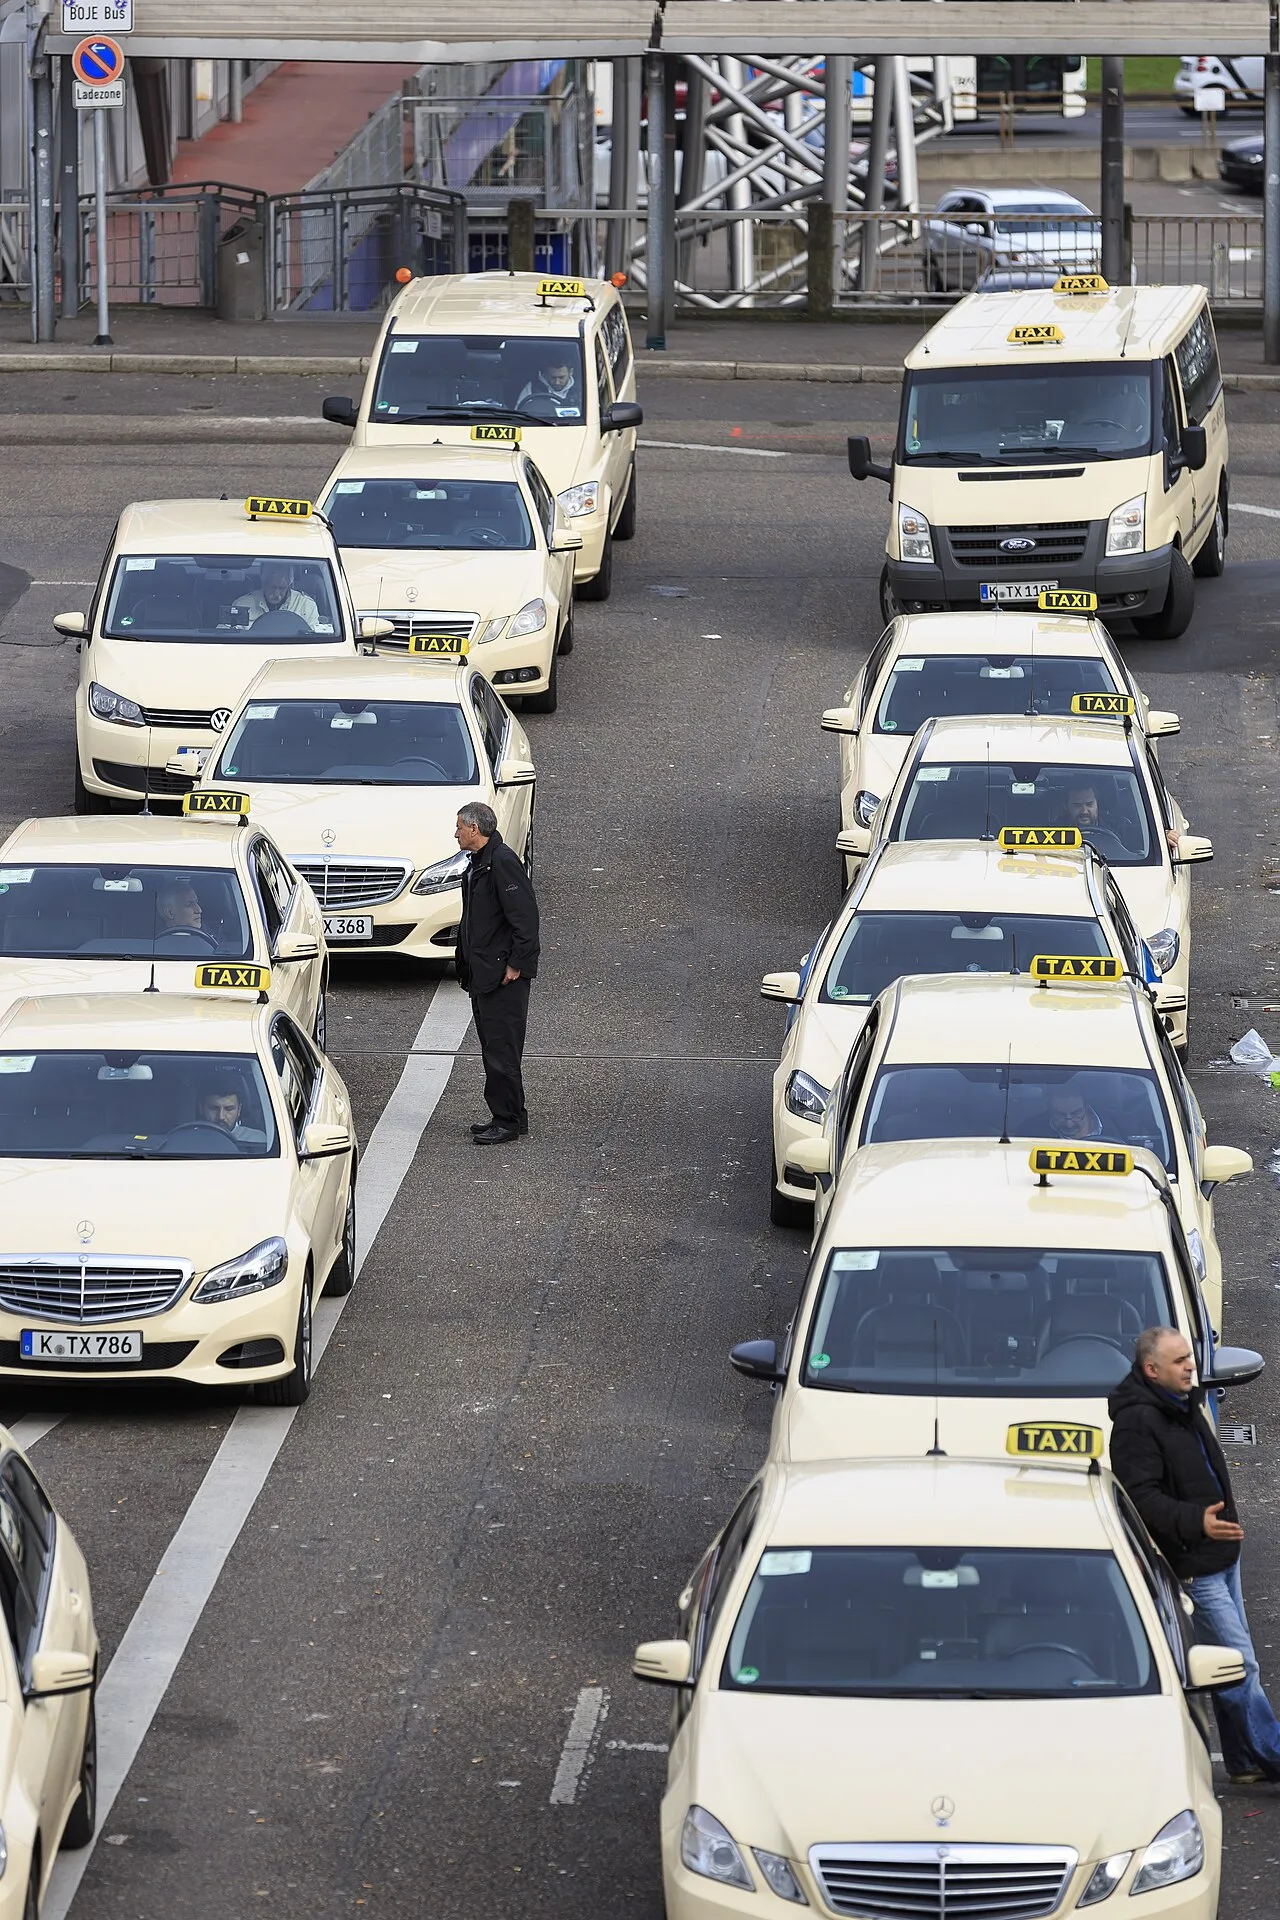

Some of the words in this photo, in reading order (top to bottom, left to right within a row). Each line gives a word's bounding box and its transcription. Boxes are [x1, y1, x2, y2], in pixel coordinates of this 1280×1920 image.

[70, 6, 98, 20] BOJE
[104, 6, 125, 20] Bus
[76, 88, 121, 100] Ladezone
[543, 282, 578, 293] TAXI
[1062, 278, 1099, 289] TAXI
[1016, 326, 1055, 337] TAXI
[479, 426, 513, 439] TAXI
[257, 500, 301, 514] TAXI
[989, 586, 999, 598] K
[1006, 586, 1022, 598] TX
[1049, 594, 1087, 606] TAXI
[419, 639, 458, 652] TAXI
[1083, 697, 1124, 711] TAXI
[194, 796, 237, 810] TAXI
[1012, 830, 1067, 844] TAXI
[336, 919, 365, 934] 368
[1045, 959, 1106, 976] TAXI
[207, 970, 256, 986] TAXI
[1046, 1152, 1114, 1170] TAXI
[40, 1335, 52, 1354] K
[66, 1336, 91, 1354] TX
[95, 1336, 132, 1355] 786
[1023, 1428, 1087, 1452] TAXI
